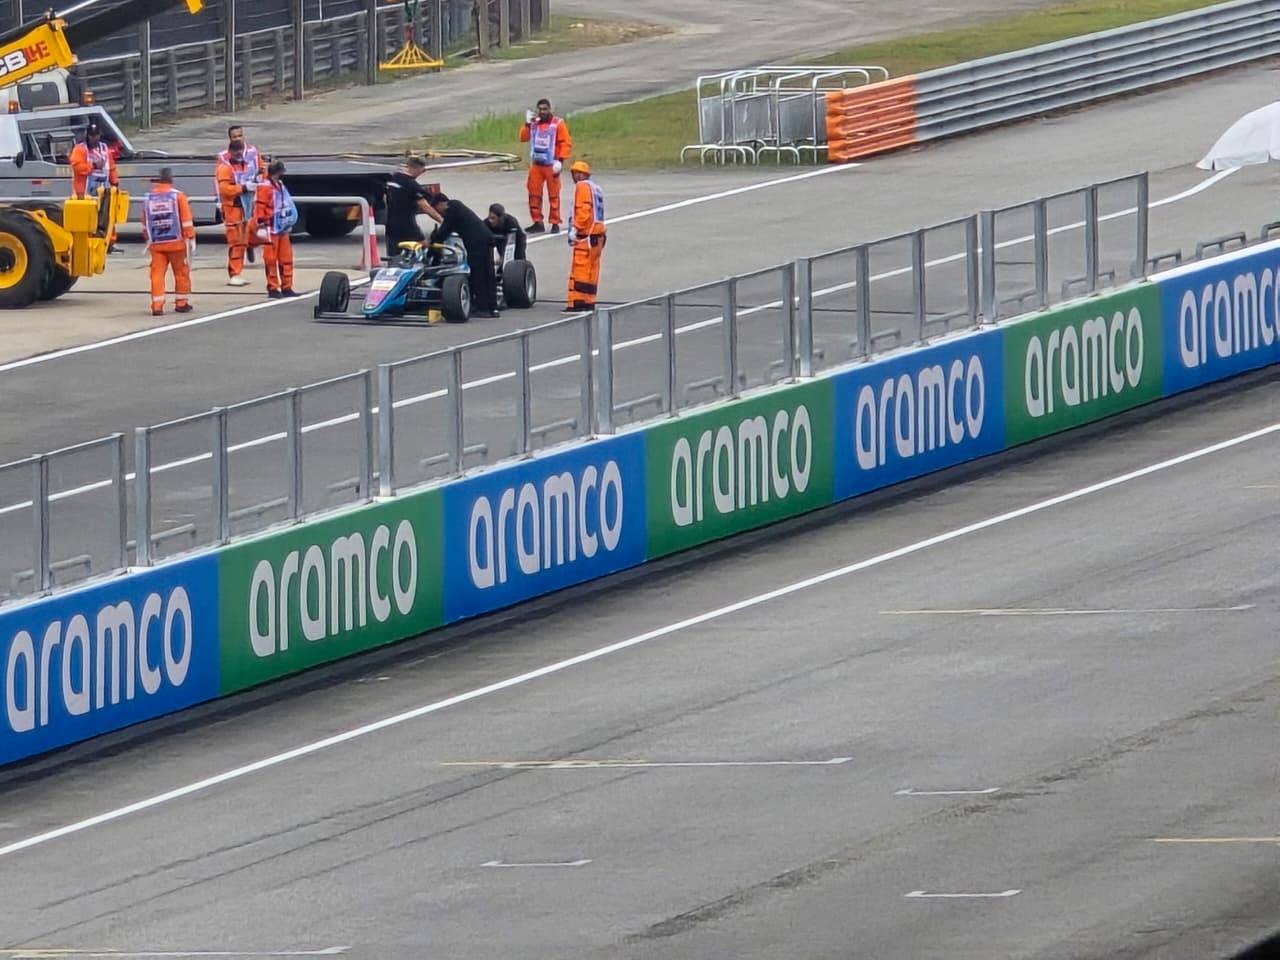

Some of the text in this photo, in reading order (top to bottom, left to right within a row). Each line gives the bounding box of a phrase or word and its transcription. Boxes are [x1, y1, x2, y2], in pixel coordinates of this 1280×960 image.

[1025, 308, 1143, 416] aramco
[1181, 268, 1280, 367] aramc
[671, 406, 811, 525] aramco
[856, 356, 984, 468] aramco
[470, 461, 622, 588] aramco
[250, 520, 417, 656] aramco
[7, 587, 191, 731] aramco
